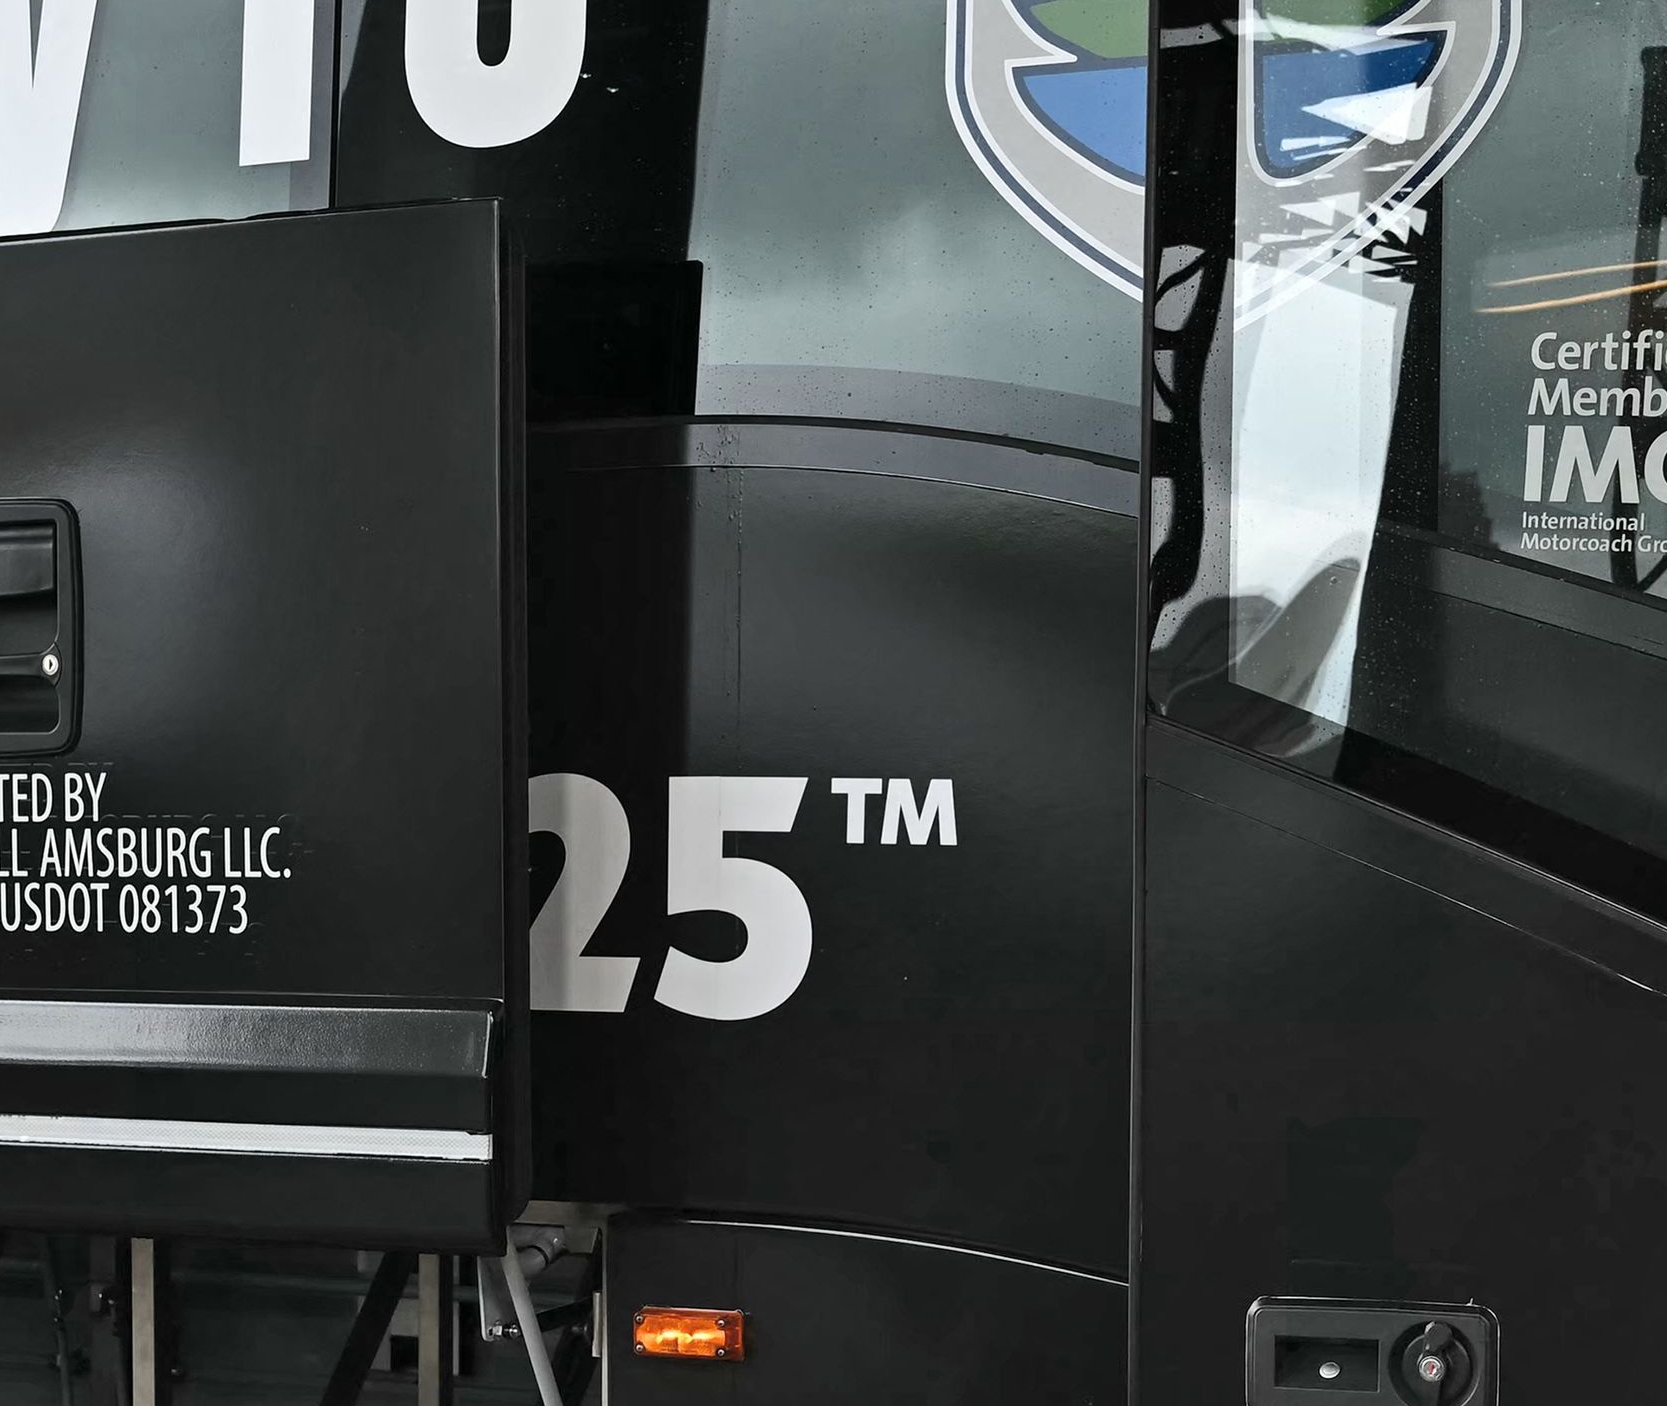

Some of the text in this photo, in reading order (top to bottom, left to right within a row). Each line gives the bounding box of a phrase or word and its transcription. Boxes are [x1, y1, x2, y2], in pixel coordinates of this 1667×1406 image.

[1520, 532, 1632, 553] Motorcoach
[1522, 511, 1645, 531] International
[64, 773, 107, 823] BY
[224, 827, 292, 879] LLC.
[0, 882, 110, 932] USDOT
[119, 884, 248, 934] 081373
